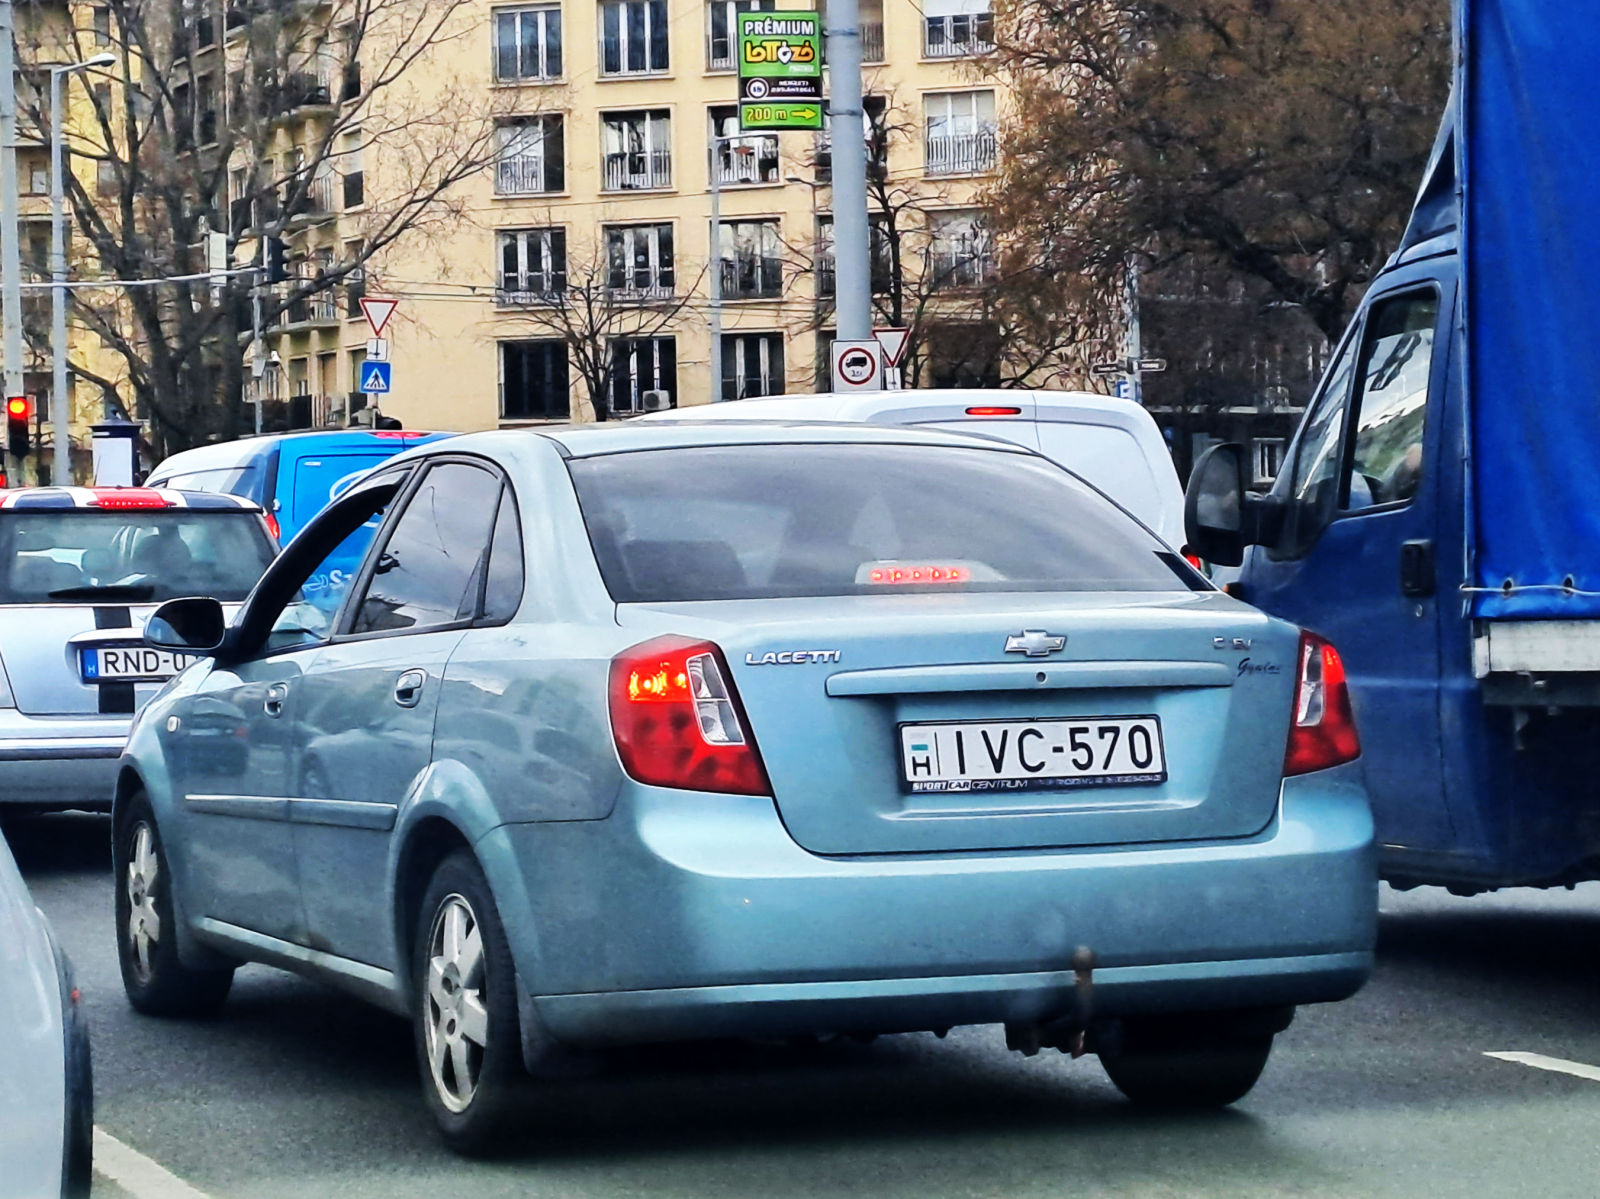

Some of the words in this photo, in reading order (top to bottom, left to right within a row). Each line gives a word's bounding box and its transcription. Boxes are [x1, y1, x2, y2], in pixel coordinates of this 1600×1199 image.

[744, 16, 814, 35] PRÉMIUM
[746, 108, 771, 121] 200
[775, 110, 787, 120] m
[103, 650, 199, 673] RND-0
[745, 649, 841, 665] LACETTI
[88, 665, 96, 674] H
[955, 724, 1154, 775] IVC-570
[911, 756, 932, 776] H
